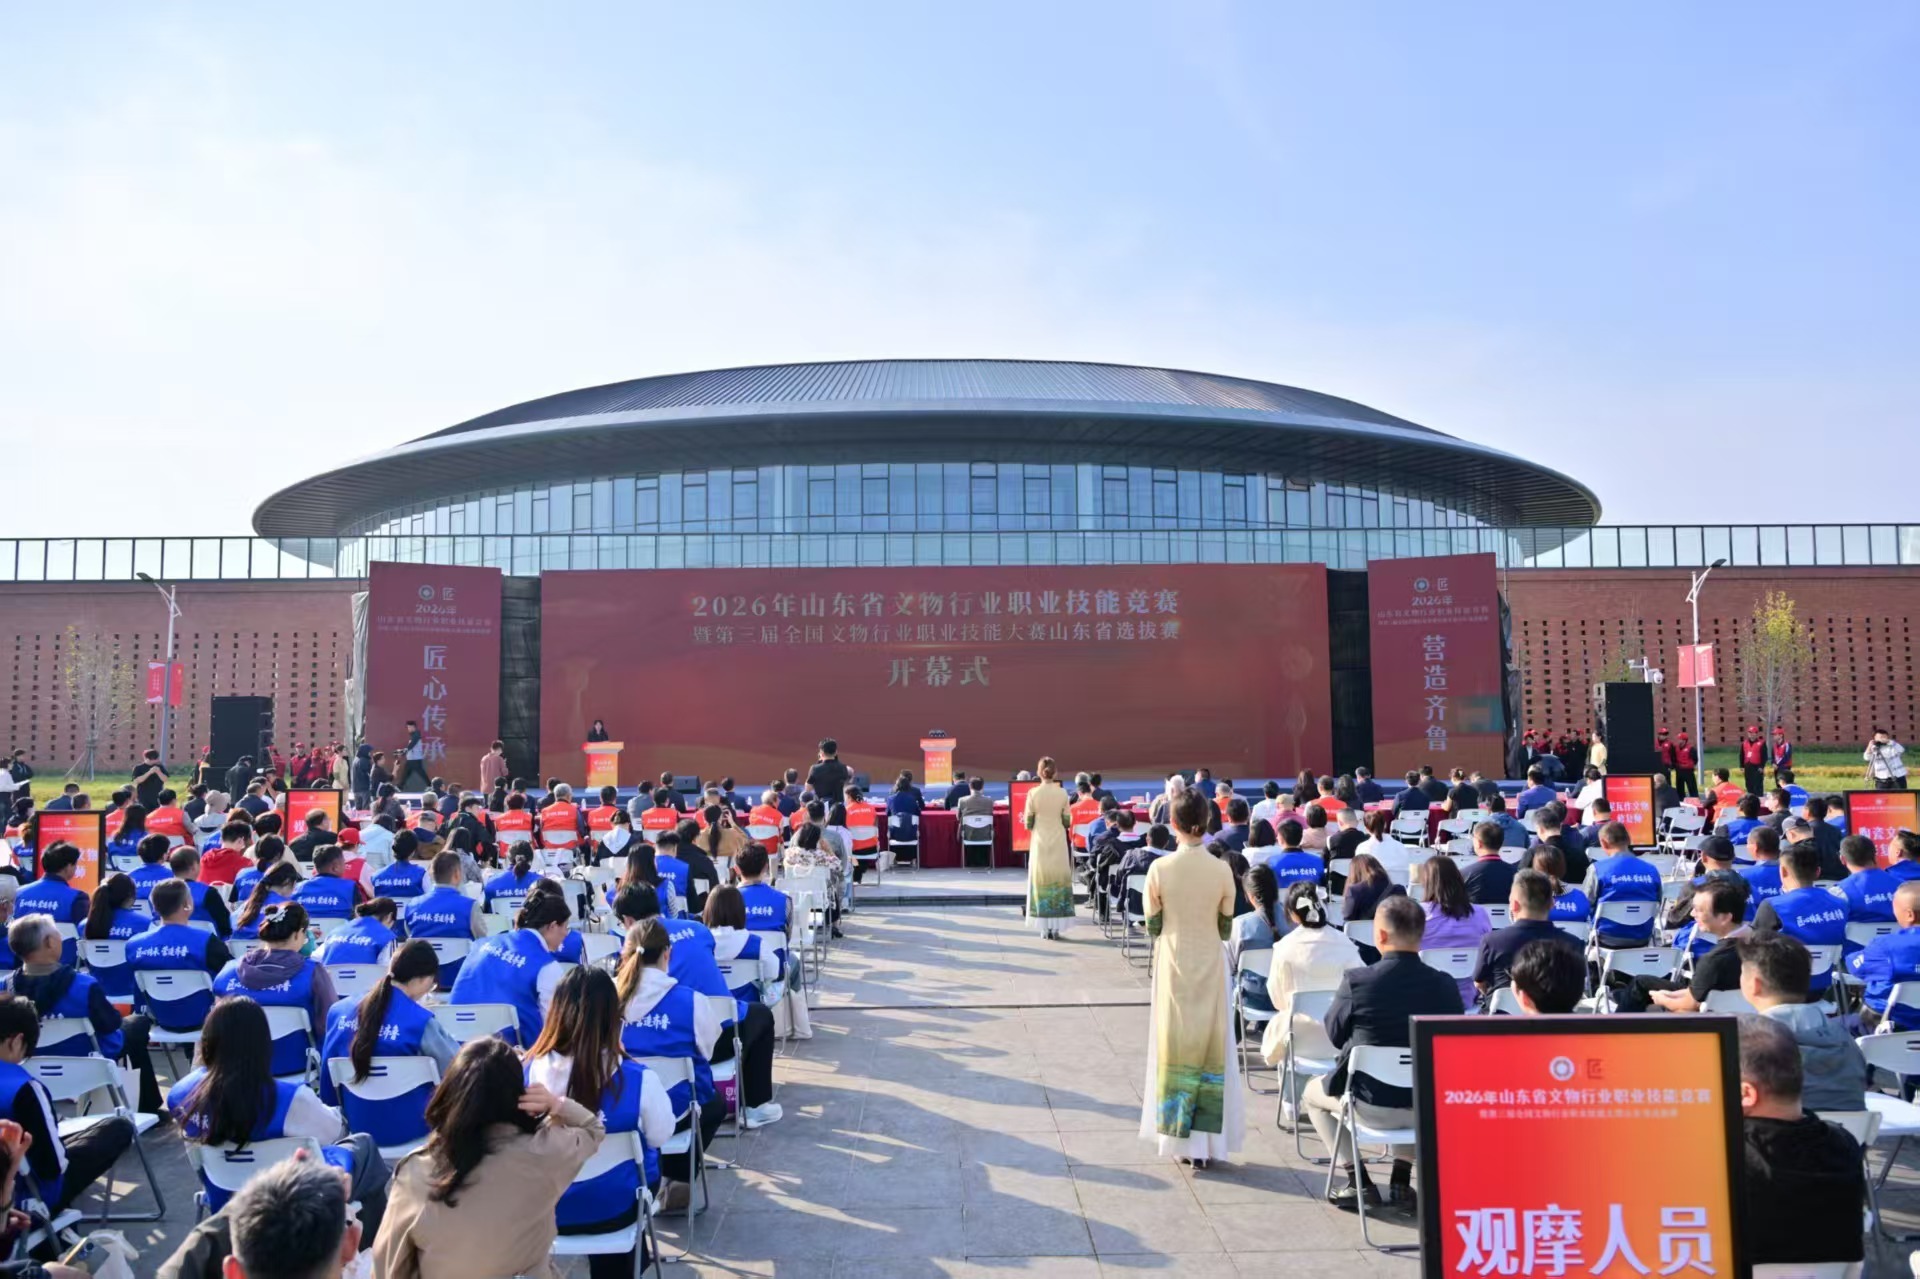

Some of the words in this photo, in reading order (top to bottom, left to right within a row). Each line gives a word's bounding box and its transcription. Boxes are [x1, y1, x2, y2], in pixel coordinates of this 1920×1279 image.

[692, 589, 1179, 618] 2026年山东省文物行业职业技能竞赛
[693, 621, 1181, 644] 暨第三届全国文物行业职业技能大赛山东省选拔赛
[887, 655, 990, 688] 开幕式
[1423, 634, 1449, 752] 营造齐鲁
[422, 645, 448, 766] 匠心传承
[1454, 1203, 1717, 1277] 观摩人员
